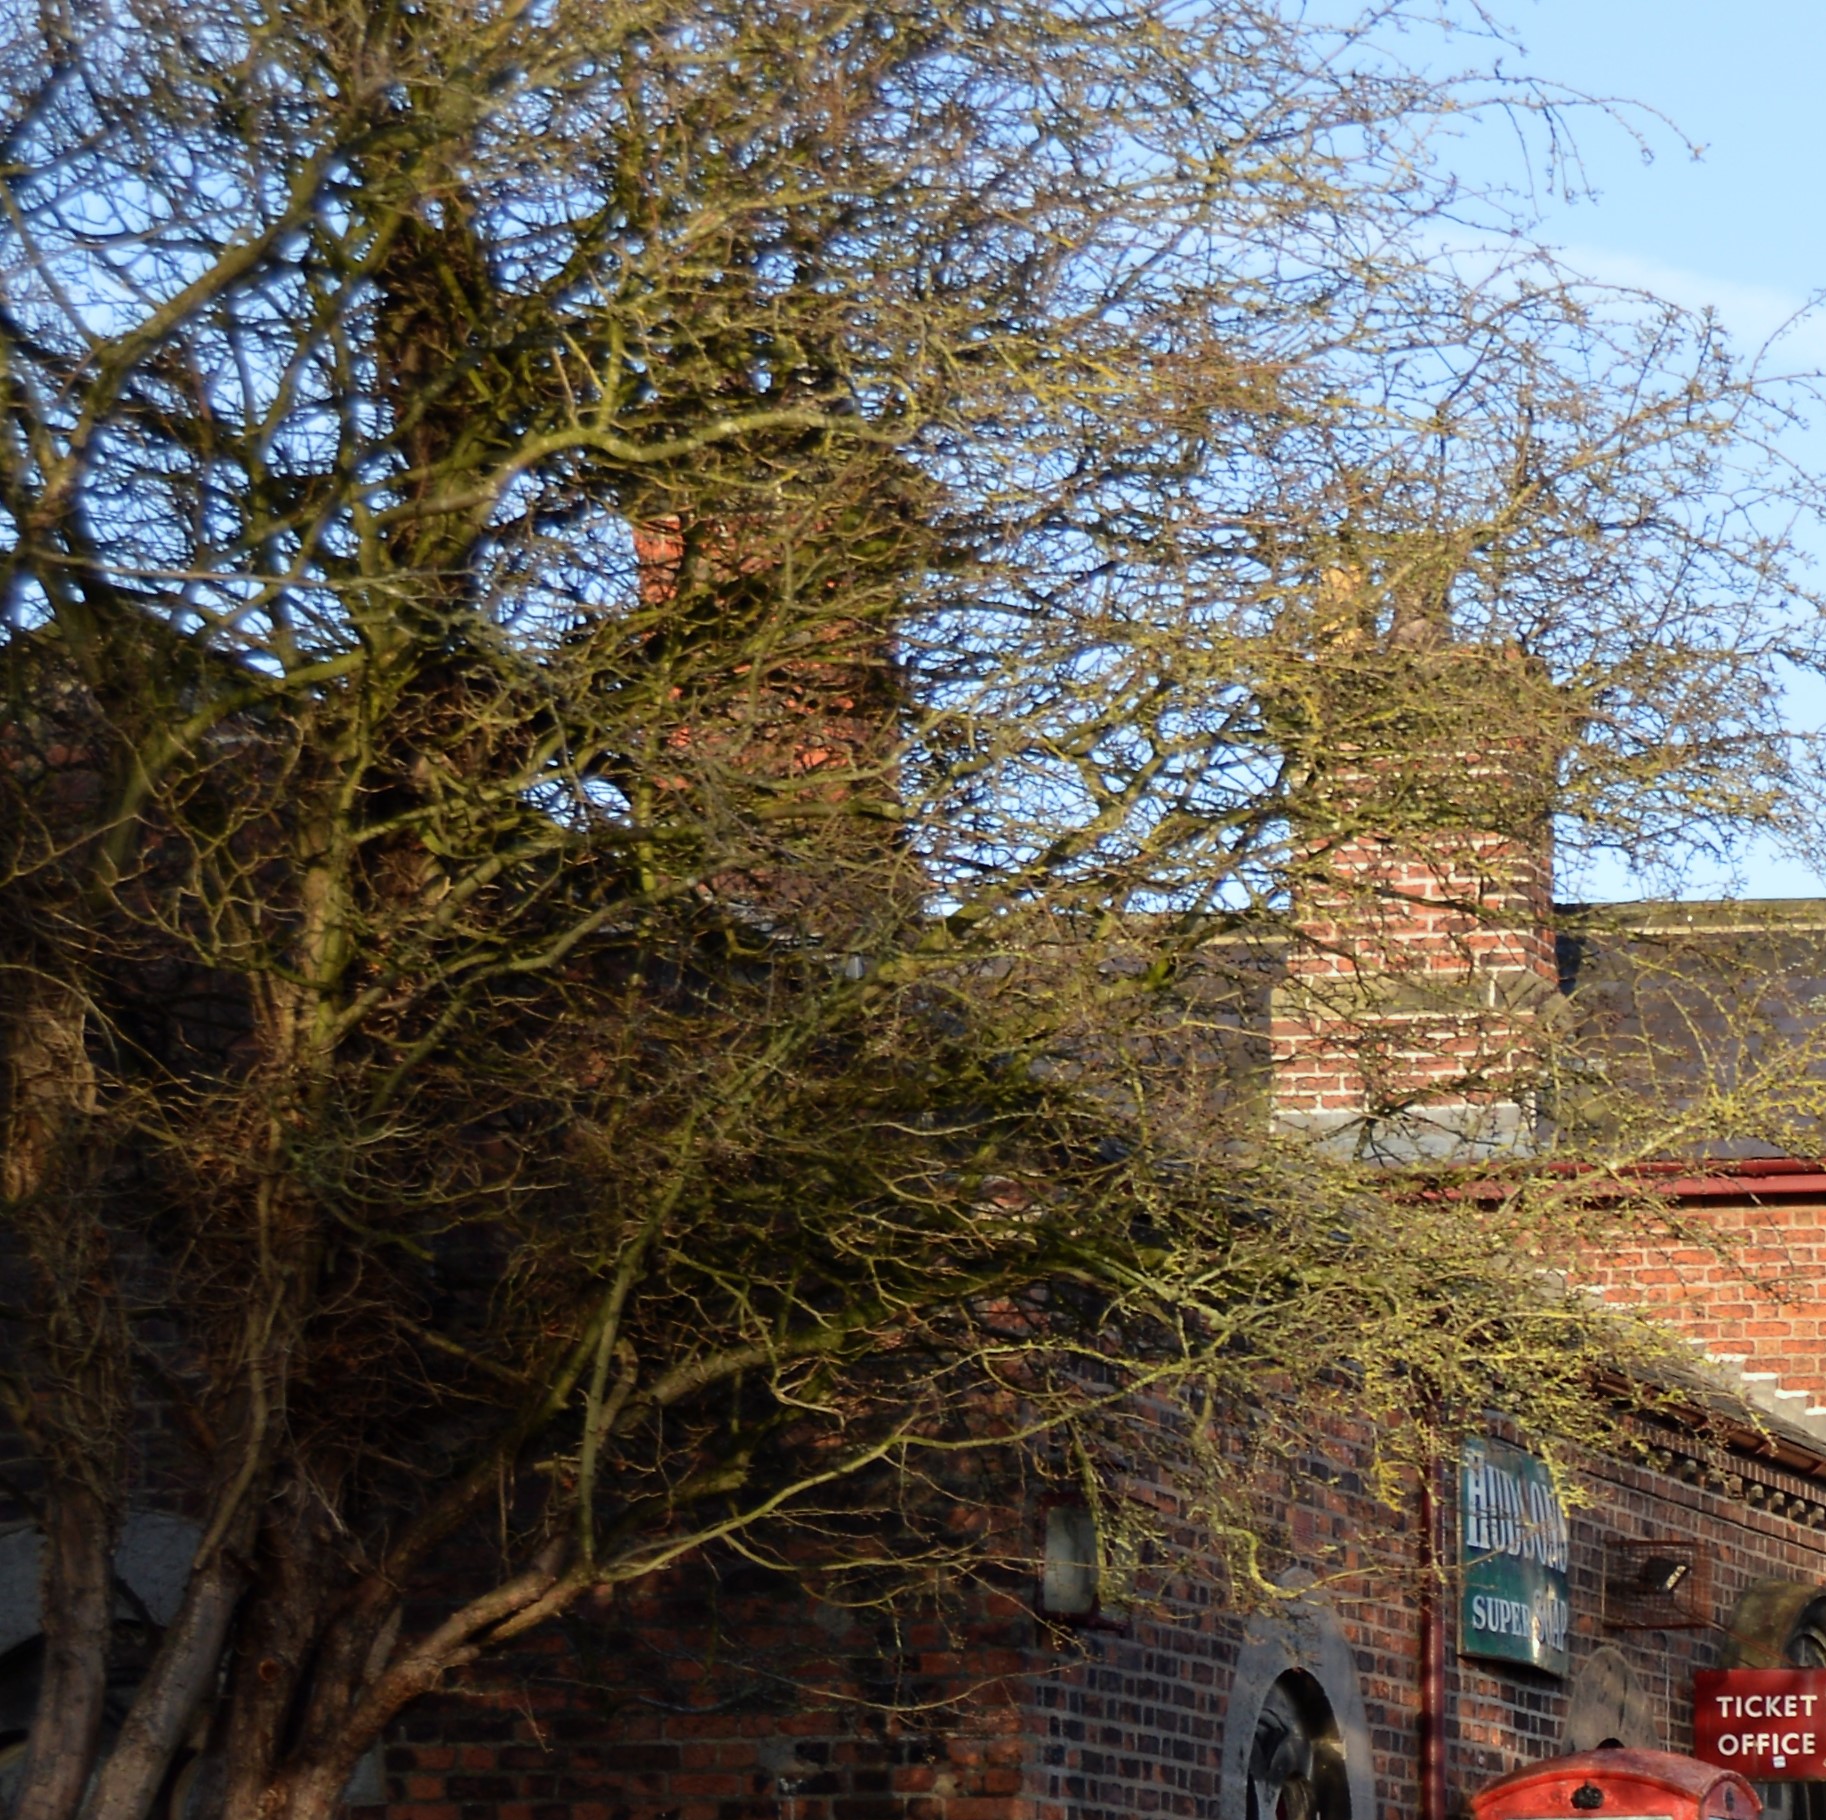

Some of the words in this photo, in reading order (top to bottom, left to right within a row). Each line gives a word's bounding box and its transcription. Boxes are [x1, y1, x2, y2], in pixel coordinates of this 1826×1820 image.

[1472, 1595, 1531, 1638] SUPER
[1533, 1588, 1568, 1652] SOAP
[1715, 1695, 1818, 1719] TICKET
[1717, 1733, 1816, 1756] OFFICE
